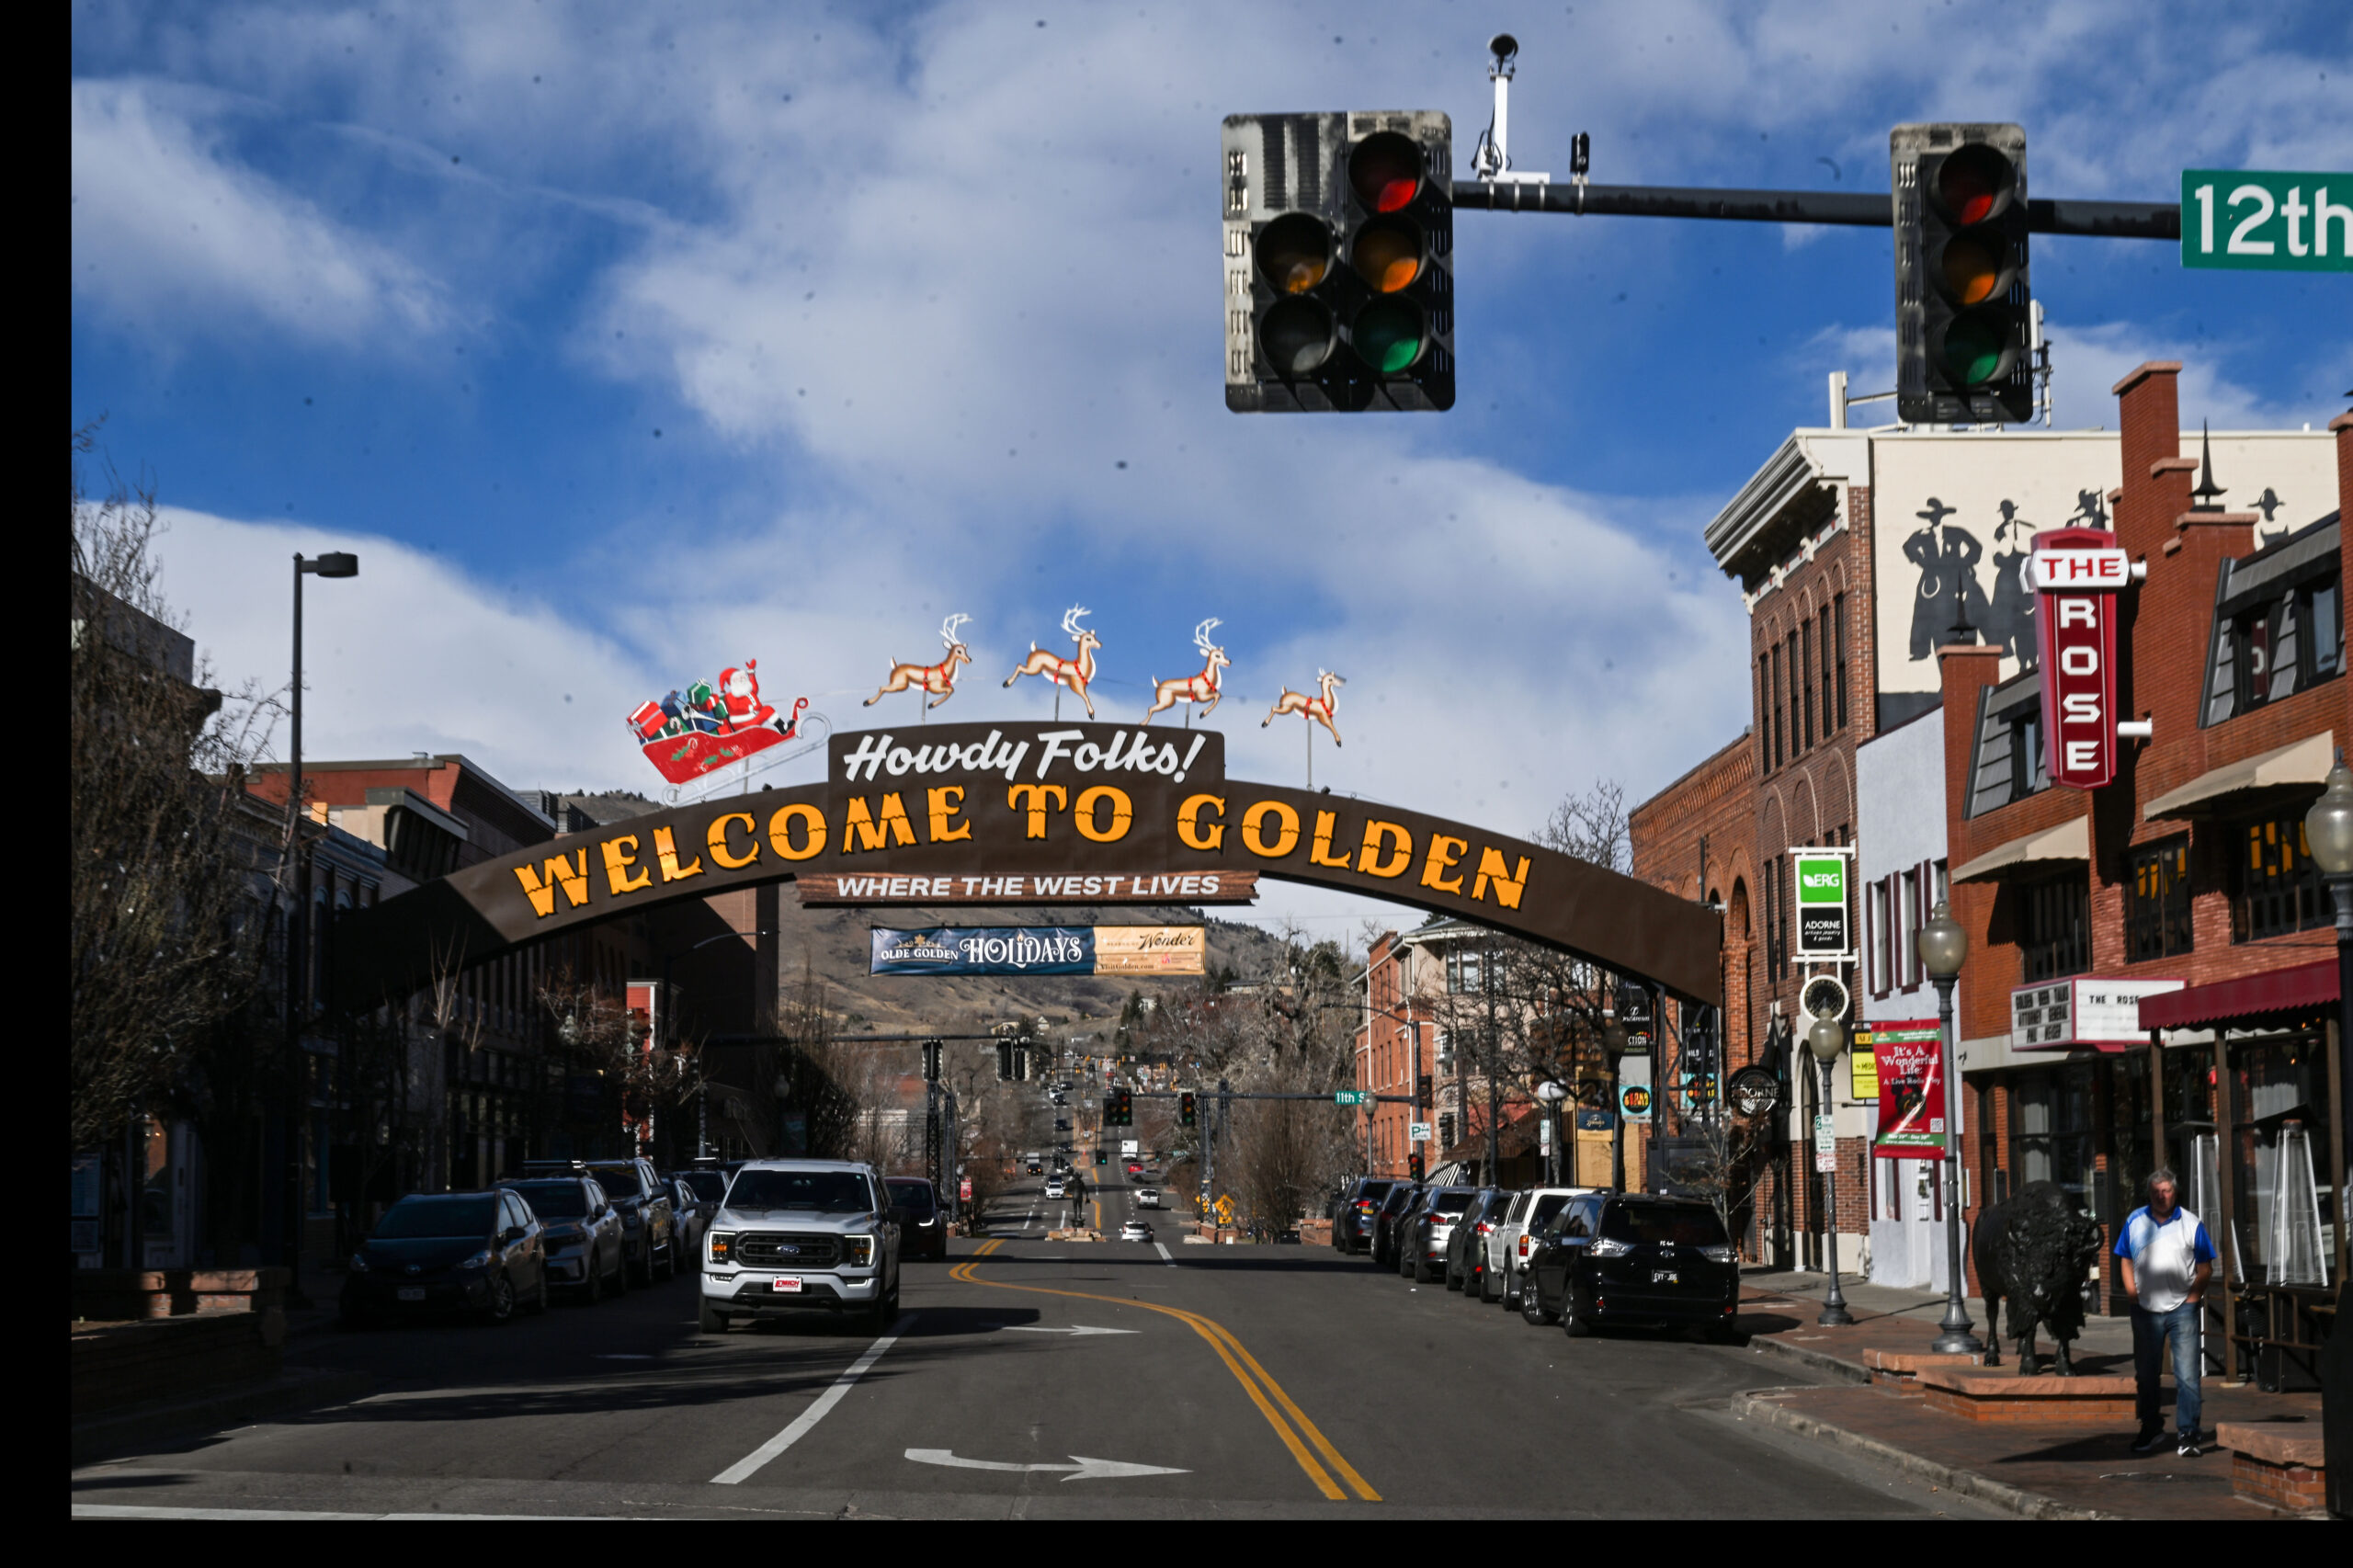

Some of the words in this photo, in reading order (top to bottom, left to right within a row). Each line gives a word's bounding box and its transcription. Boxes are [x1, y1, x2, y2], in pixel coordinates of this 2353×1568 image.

[2195, 184, 2353, 256] 12th
[2040, 557, 2122, 580] THE
[2059, 598, 2102, 772] ROSE
[843, 730, 1029, 782] Howdy
[1037, 729, 1206, 783] Folks!
[513, 784, 972, 919] WELCOME
[1007, 783, 1134, 844] TO
[1176, 793, 1533, 912] GOLDEN
[836, 877, 952, 897] WHERE
[961, 877, 1024, 896] THE
[1034, 876, 1124, 896] WEST
[1131, 875, 1221, 895] LIVES
[1813, 873, 1840, 888] ERG
[1804, 920, 1841, 930] ADORNE
[1138, 932, 1195, 950] Wonder
[881, 949, 909, 960] OLDE
[914, 949, 959, 960] GOLDEN
[2089, 995, 2106, 1004] THE
[1893, 1046, 1912, 1057] It's
[1915, 1045, 1925, 1056] A
[1881, 1053, 1938, 1066] Wonderful
[1336, 1092, 1355, 1103] 11th
[1733, 1087, 1779, 1098] DORNE
